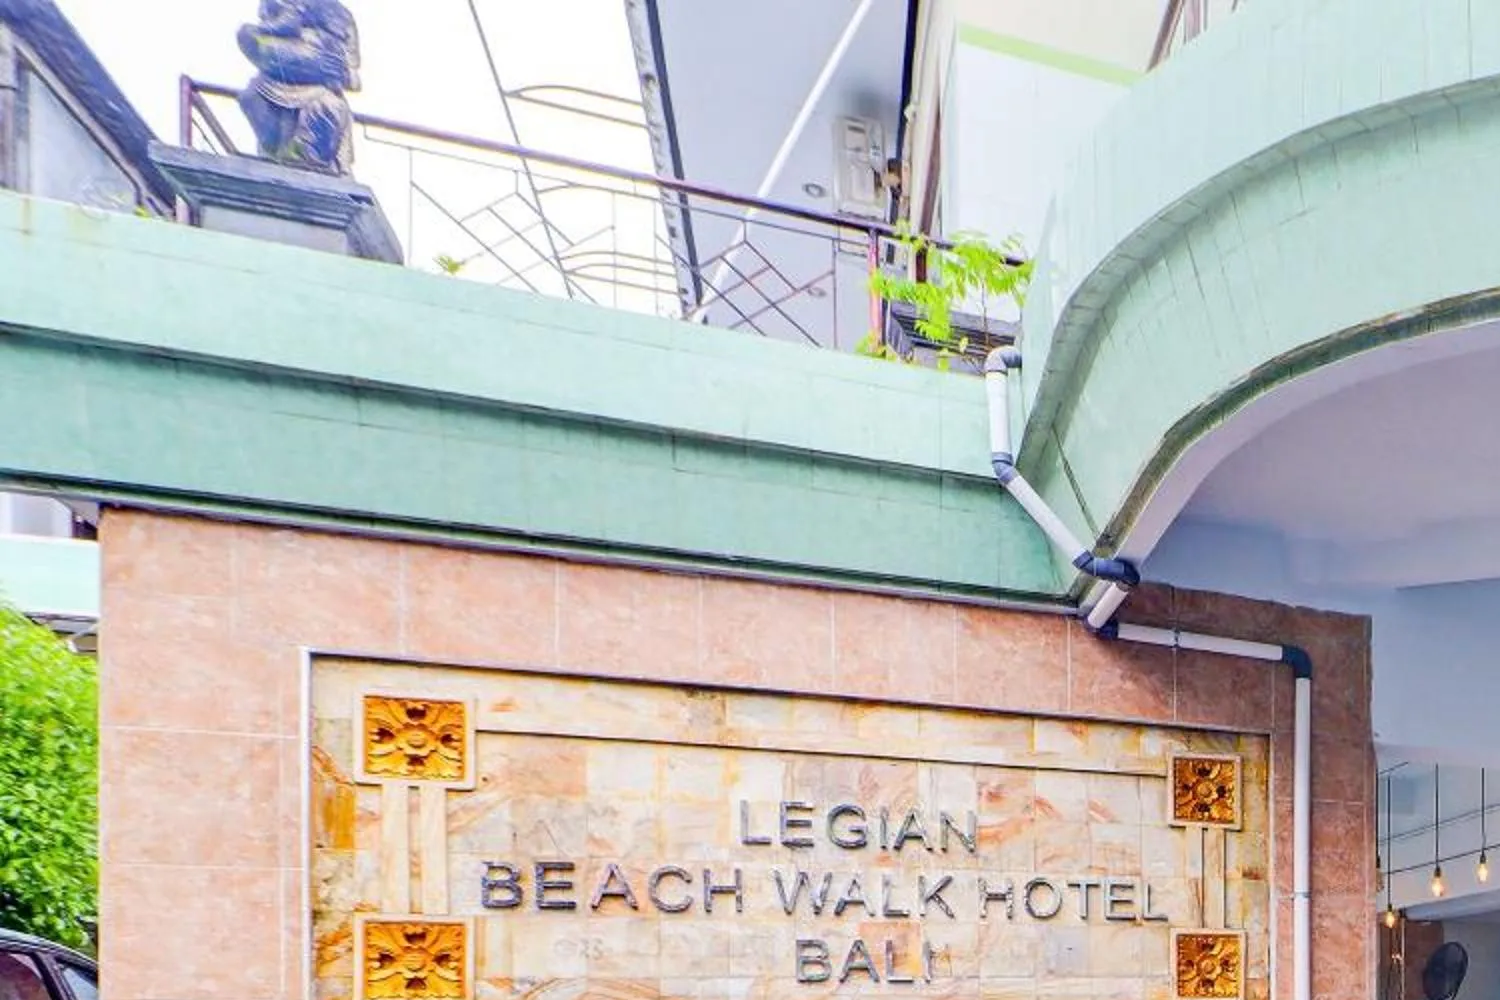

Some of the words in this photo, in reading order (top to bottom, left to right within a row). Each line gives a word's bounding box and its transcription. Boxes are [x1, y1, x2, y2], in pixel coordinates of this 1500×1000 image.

[739, 800, 977, 853] LEGIAN
[481, 860, 742, 913] BEACH
[771, 868, 955, 919] WALK
[977, 875, 1168, 922] HOTEL
[795, 939, 932, 984] BALI
